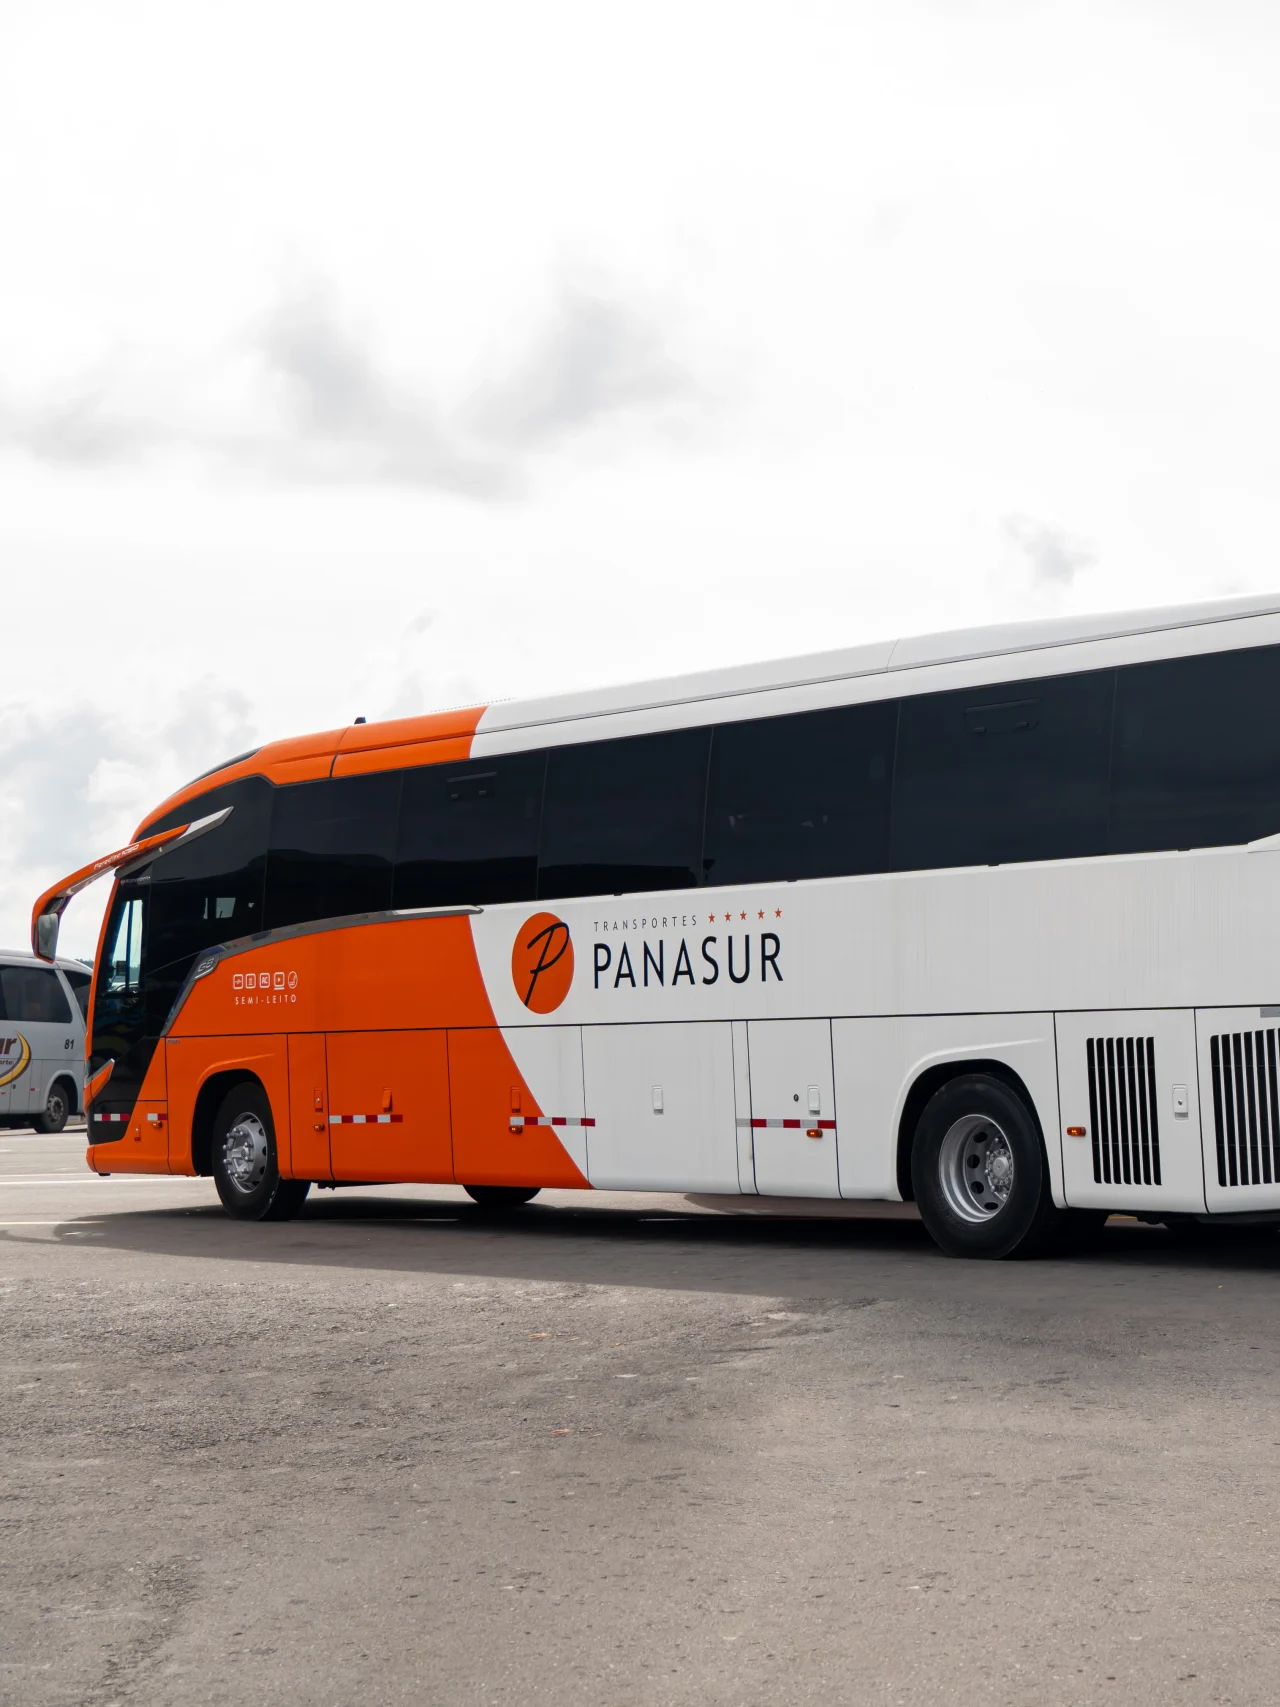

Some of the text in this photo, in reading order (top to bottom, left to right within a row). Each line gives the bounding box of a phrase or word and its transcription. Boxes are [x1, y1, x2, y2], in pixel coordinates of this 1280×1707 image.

[594, 915, 697, 932] TRANSPORTES
[593, 932, 783, 989] PANASUR
[262, 976, 268, 984] AC
[235, 994, 296, 1005] SEMI-LEITO
[0, 1038, 17, 1055] r
[64, 1039, 74, 1050] 81
